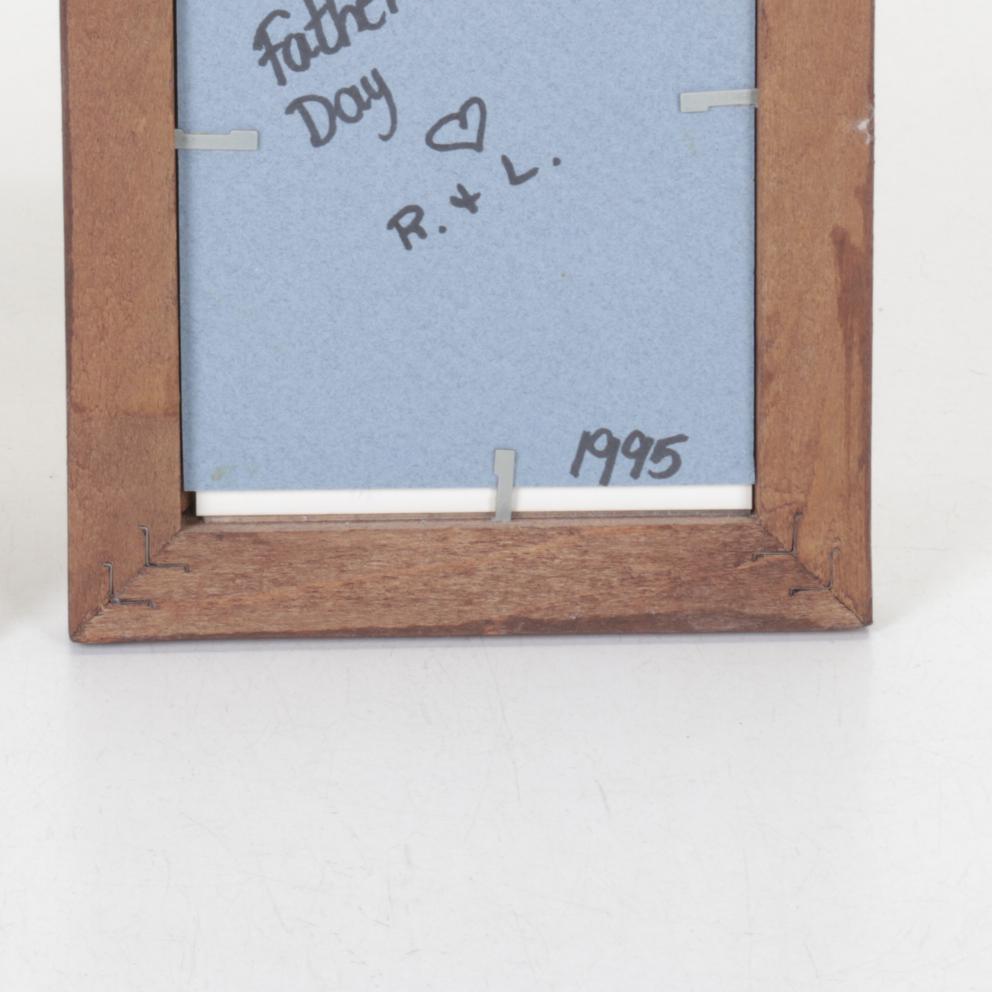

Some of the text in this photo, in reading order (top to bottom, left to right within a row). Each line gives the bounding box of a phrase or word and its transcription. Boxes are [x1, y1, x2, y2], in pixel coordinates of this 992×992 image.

[284, 68, 397, 148] Day
[386, 204, 447, 251] R.
[569, 427, 689, 487] 1995
